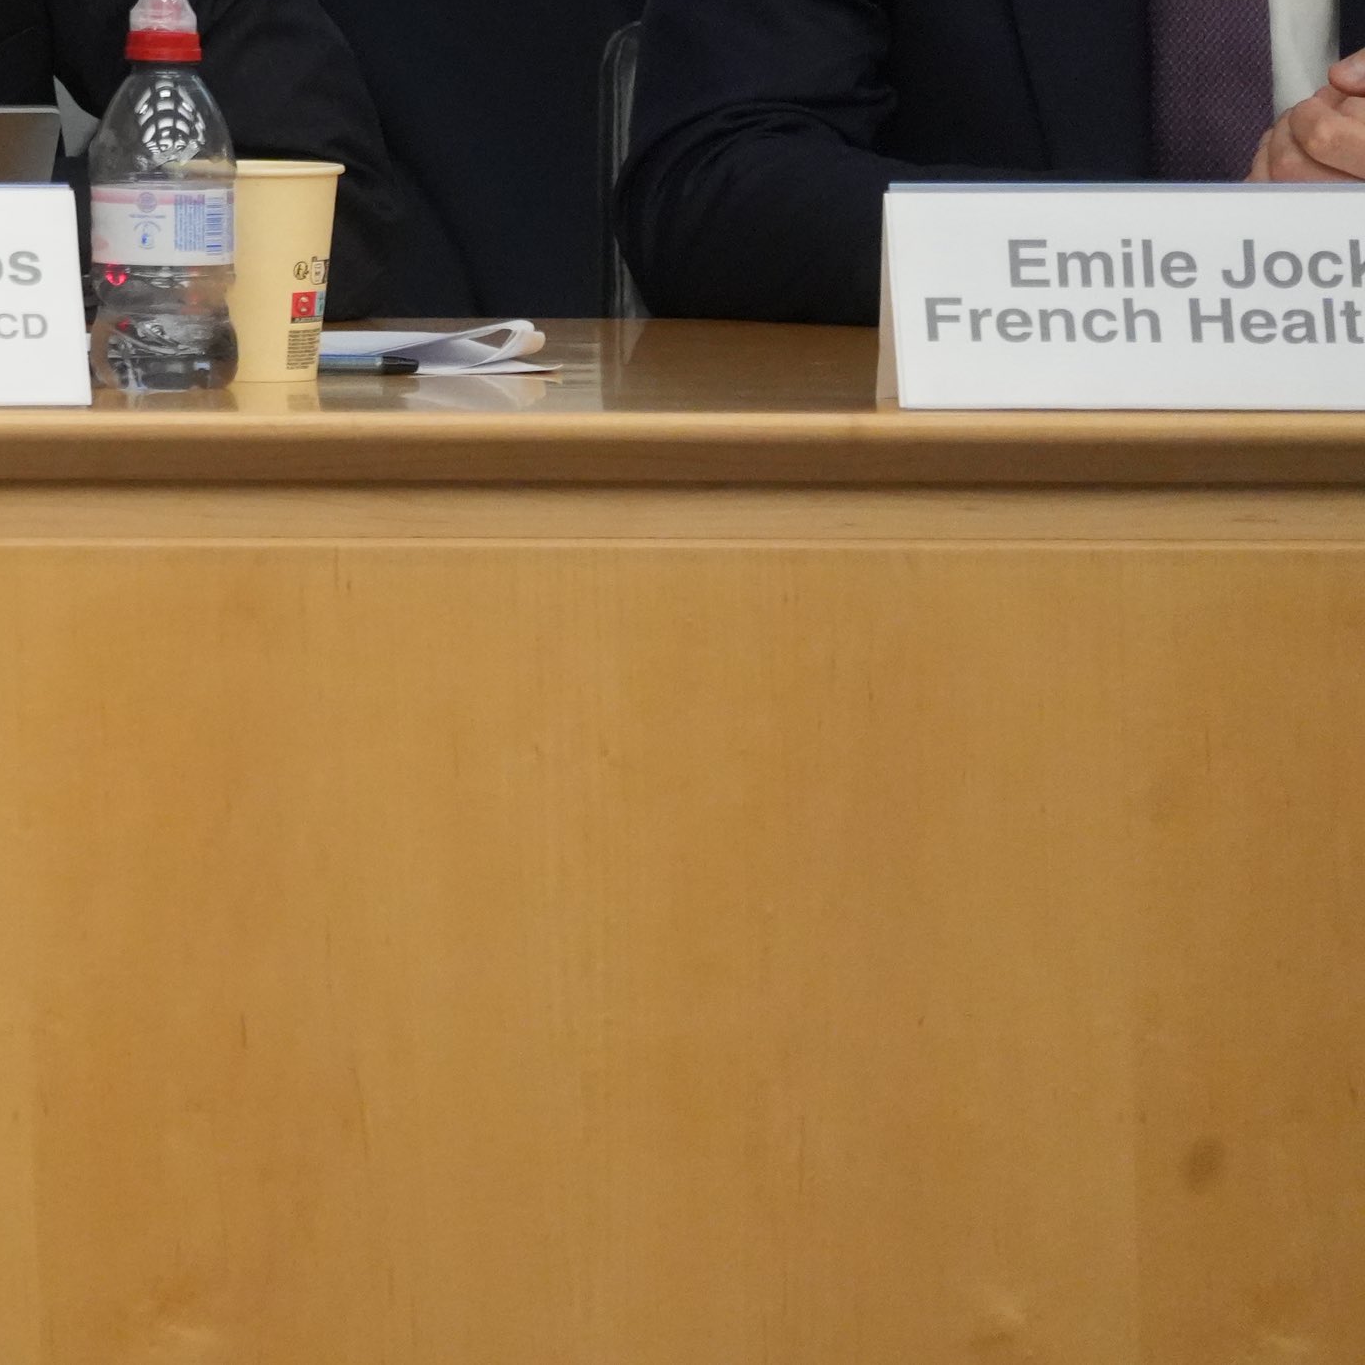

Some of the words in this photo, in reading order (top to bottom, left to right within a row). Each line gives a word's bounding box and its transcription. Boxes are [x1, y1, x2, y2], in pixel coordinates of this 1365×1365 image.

[1007, 238, 1198, 289] Emile
[924, 296, 1162, 344] French
[1188, 297, 1365, 345] Healt
